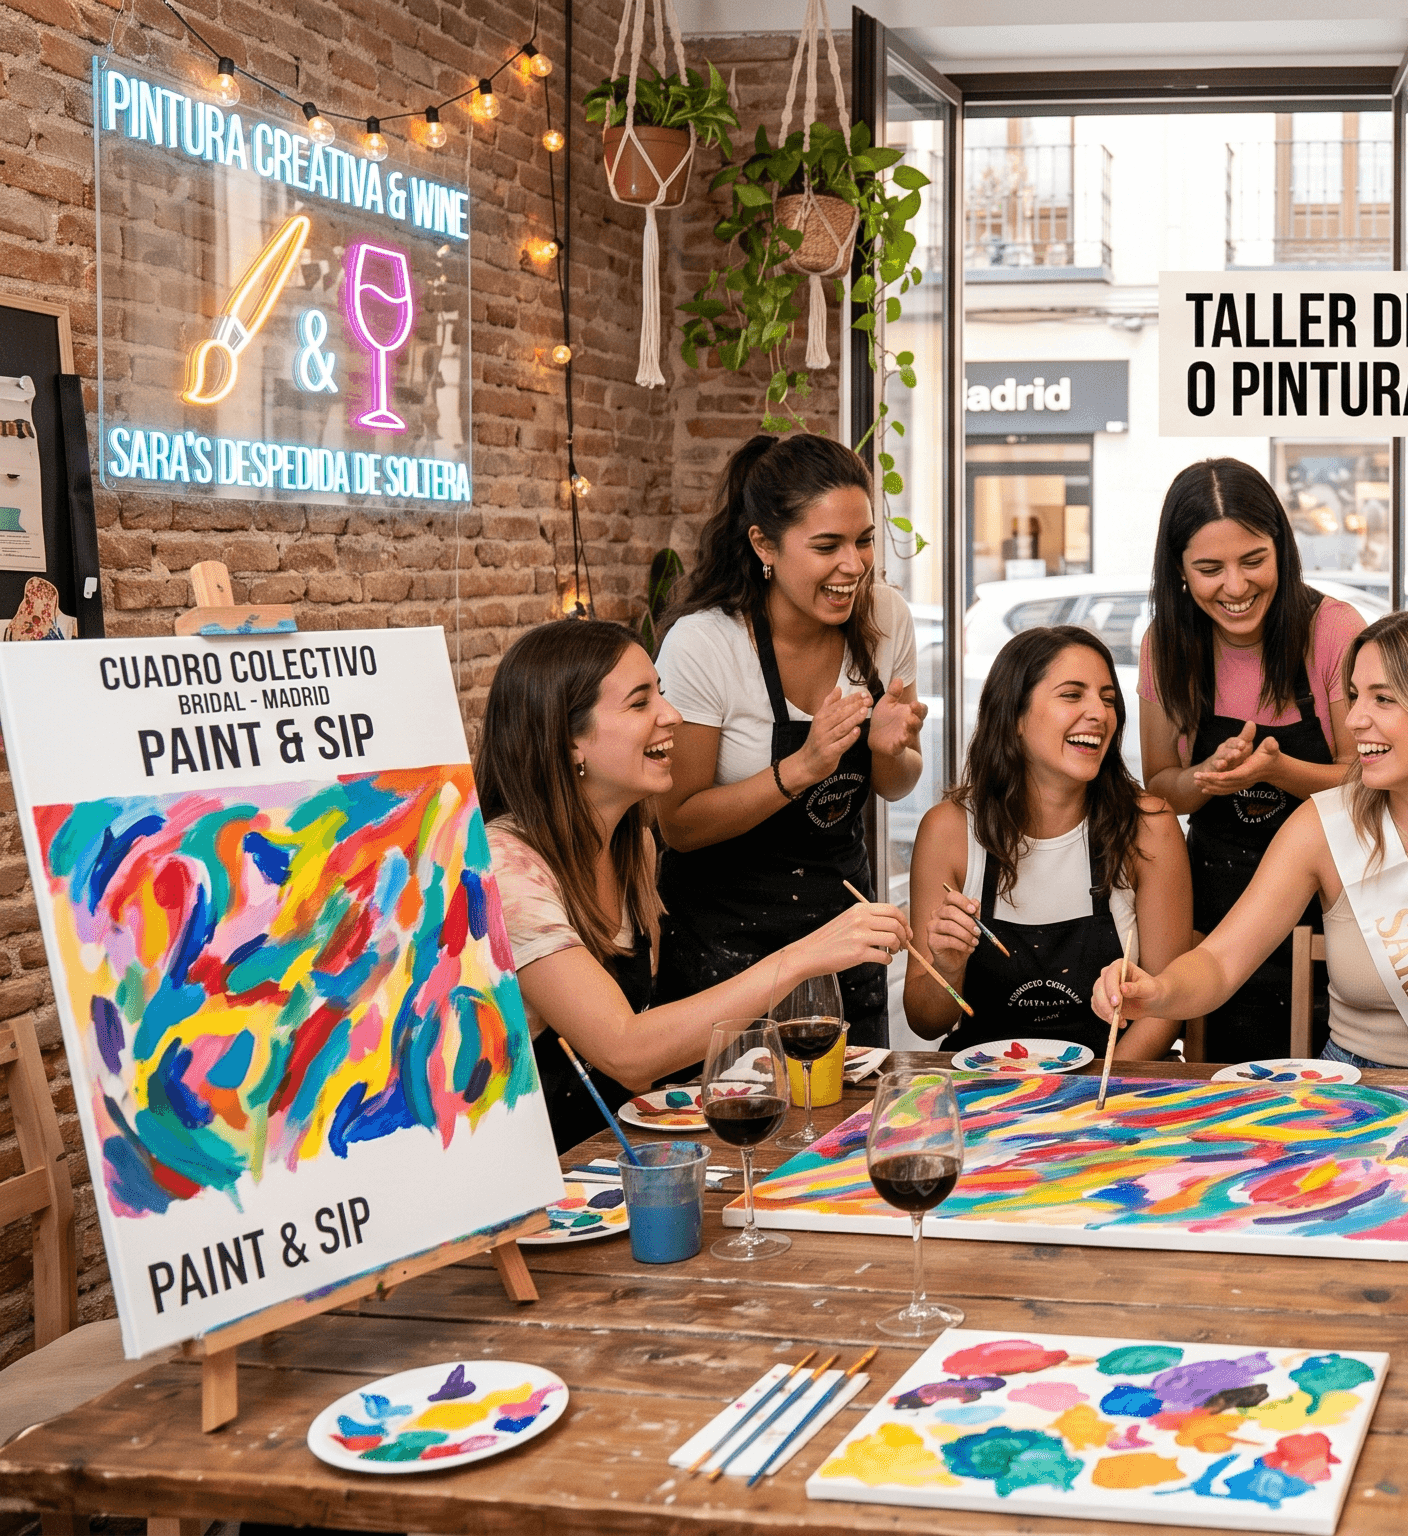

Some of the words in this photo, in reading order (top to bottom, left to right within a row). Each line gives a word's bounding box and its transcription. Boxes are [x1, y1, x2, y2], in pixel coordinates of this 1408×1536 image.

[102, 70, 248, 170] PINTURA
[252, 122, 384, 214] CREATIVA
[387, 171, 407, 220] &
[408, 176, 469, 240] WINE
[1186, 292, 1357, 348] TALLER
[295, 309, 339, 394] &
[963, 376, 1072, 413] adrid
[1187, 360, 1216, 417] O
[107, 426, 213, 484] SARA'S
[215, 438, 351, 494] DESPEDIDA
[352, 451, 382, 496] DE
[383, 455, 471, 502] SOLTERA
[100, 653, 223, 691] CUADRO
[229, 645, 378, 684] COLECTIVO
[177, 690, 247, 716] BRIDAL
[261, 685, 331, 710] MADRID
[137, 721, 262, 778] PAINT
[276, 718, 306, 765] &
[313, 713, 375, 761] SIP
[147, 1228, 266, 1316] PAINT
[280, 1221, 310, 1268] &
[314, 1196, 371, 1255] SIP
